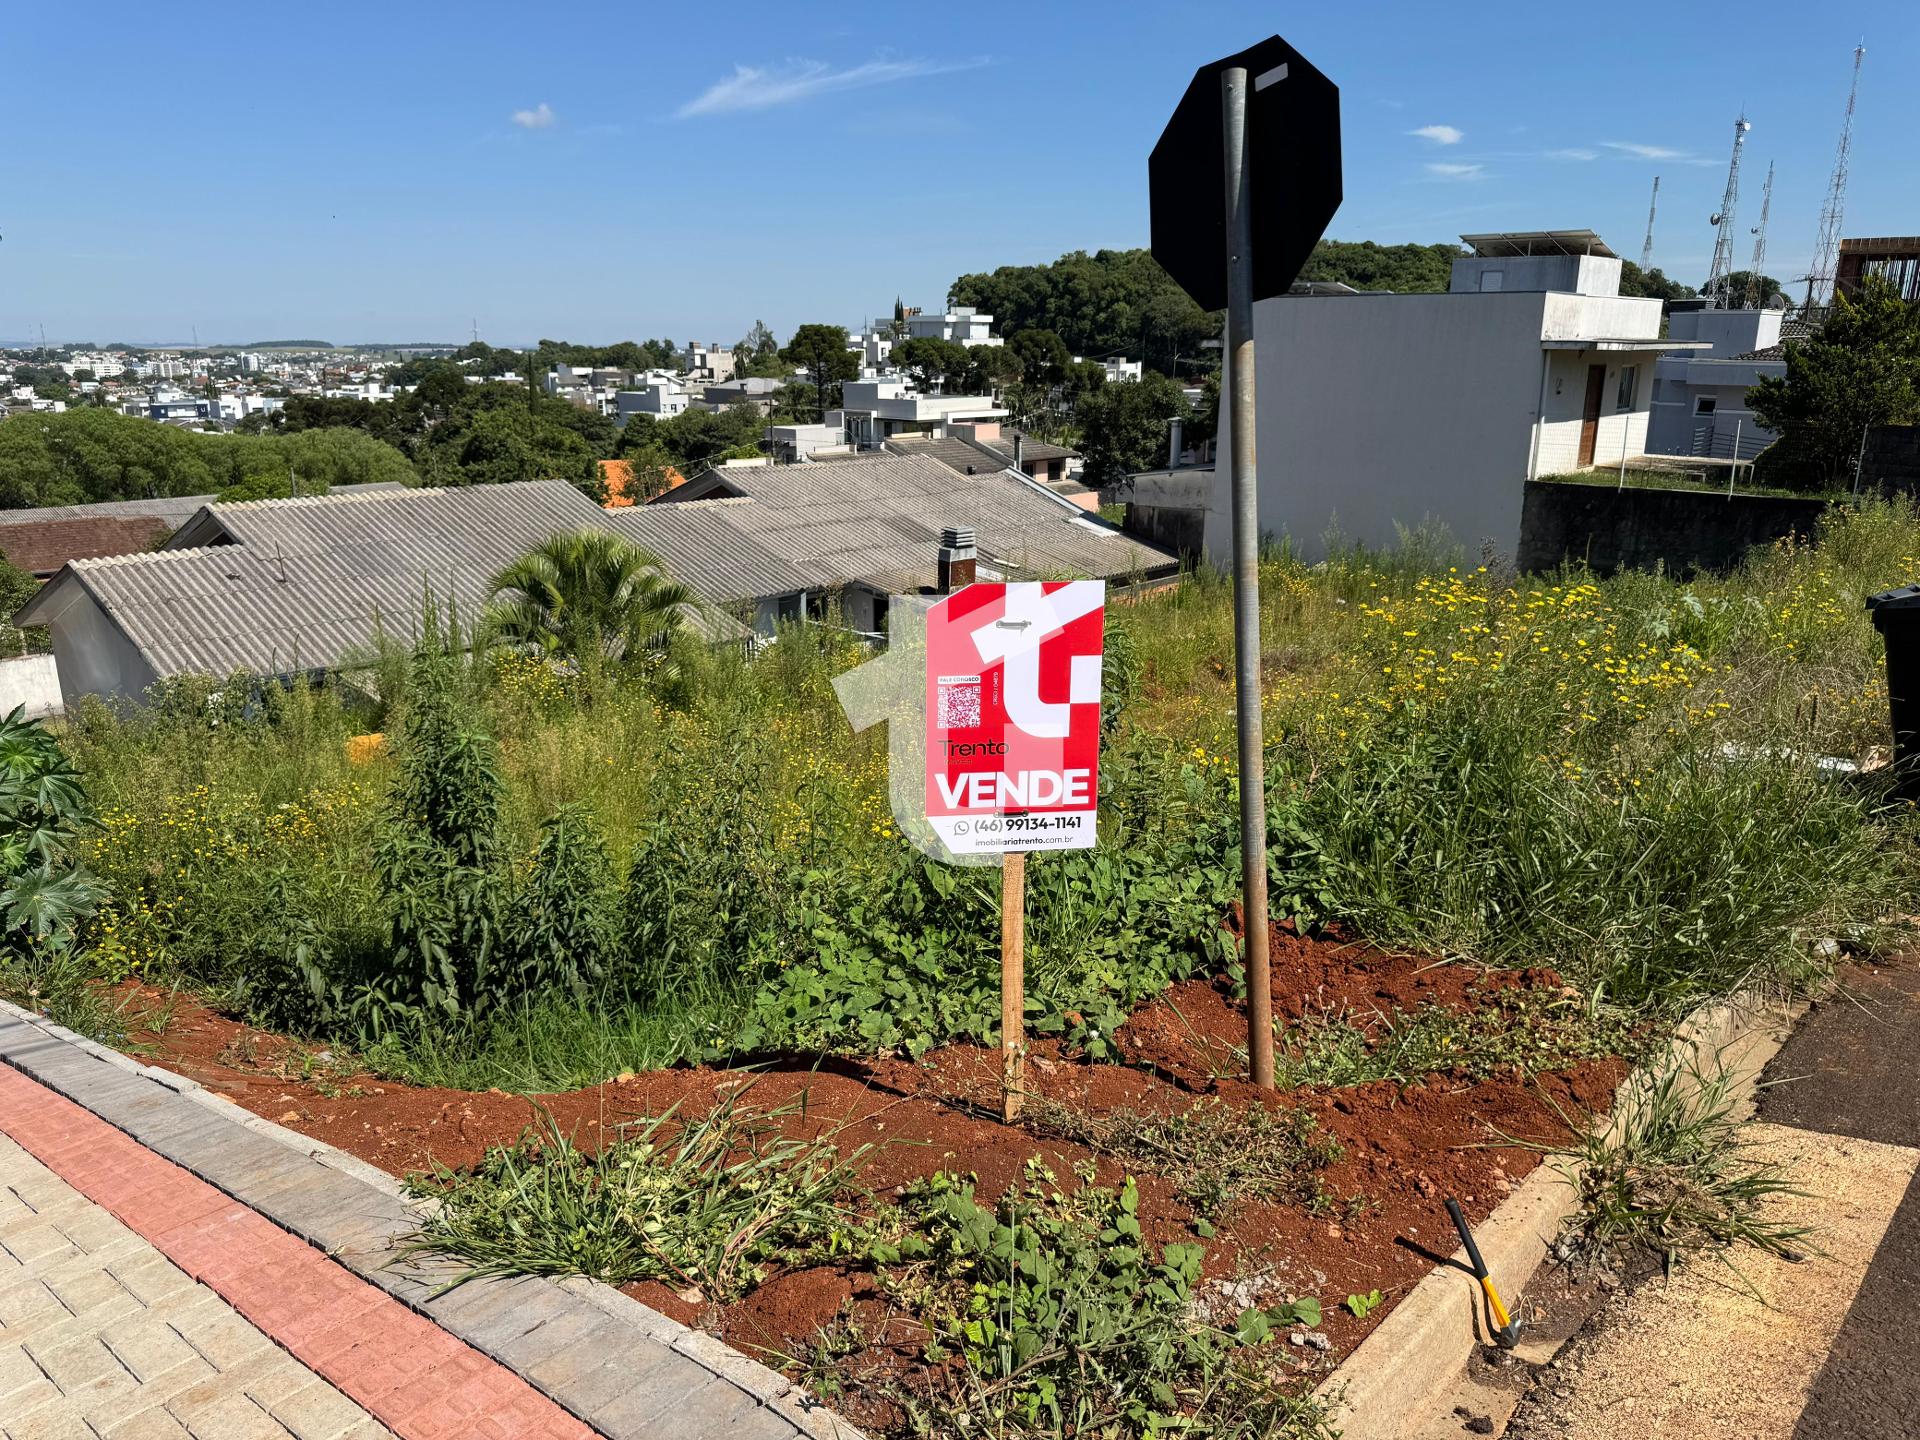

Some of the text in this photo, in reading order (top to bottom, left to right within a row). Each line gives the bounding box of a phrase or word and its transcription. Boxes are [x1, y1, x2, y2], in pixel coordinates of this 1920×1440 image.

[937, 738, 1010, 757] Trento
[934, 768, 1090, 810] VENDE
[974, 816, 1082, 834] (46) 99134-1141
[975, 836, 1074, 847] imobiliariatrento.com.br
